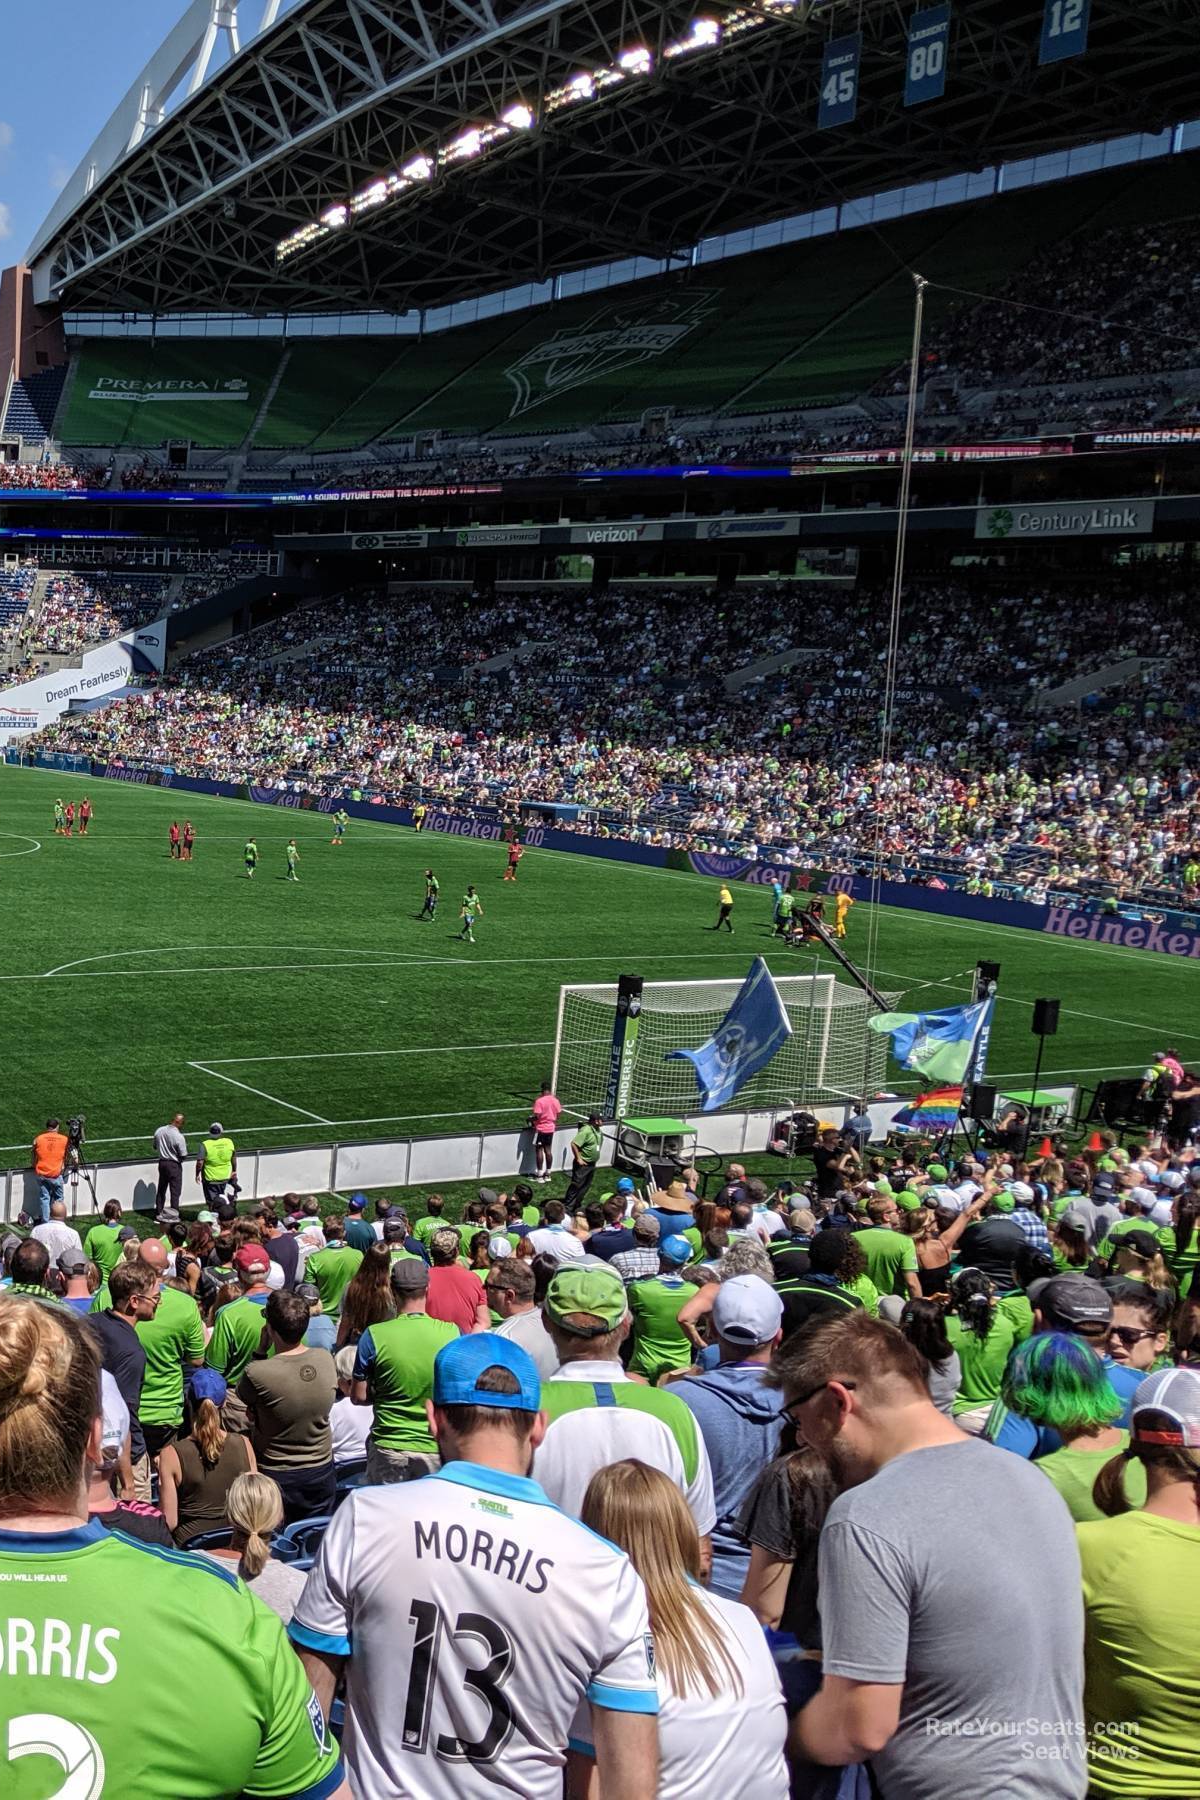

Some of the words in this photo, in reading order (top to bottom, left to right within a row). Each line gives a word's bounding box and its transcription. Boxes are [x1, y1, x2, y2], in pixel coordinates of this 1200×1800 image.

[1049, 0, 1083, 38] 12
[910, 41, 944, 81] 80
[822, 69, 855, 106] 45
[96, 377, 209, 391] PREMERA
[315, 493, 339, 501] SOUND
[341, 491, 370, 501] FUTURE
[372, 490, 395, 499] FROM
[397, 489, 411, 498] THE
[1018, 507, 1137, 532] CenturyLink
[587, 527, 638, 543] verizon
[46, 682, 78, 703] Dream
[80, 665, 129, 692] Fearlessly
[844, 688, 879, 697] DELTA
[18, 715, 38, 723] FAMILY
[104, 764, 148, 784] Heineken
[423, 811, 501, 841] Heineken
[626, 1040, 635, 1057] FC
[605, 1046, 621, 1118] SEATTLE
[413, 1520, 555, 1594] MORRIS
[13, 1573, 33, 1582] WILL
[34, 1574, 56, 1582] HEAR
[56, 1574, 68, 1582] US
[401, 1599, 517, 1764] 13
